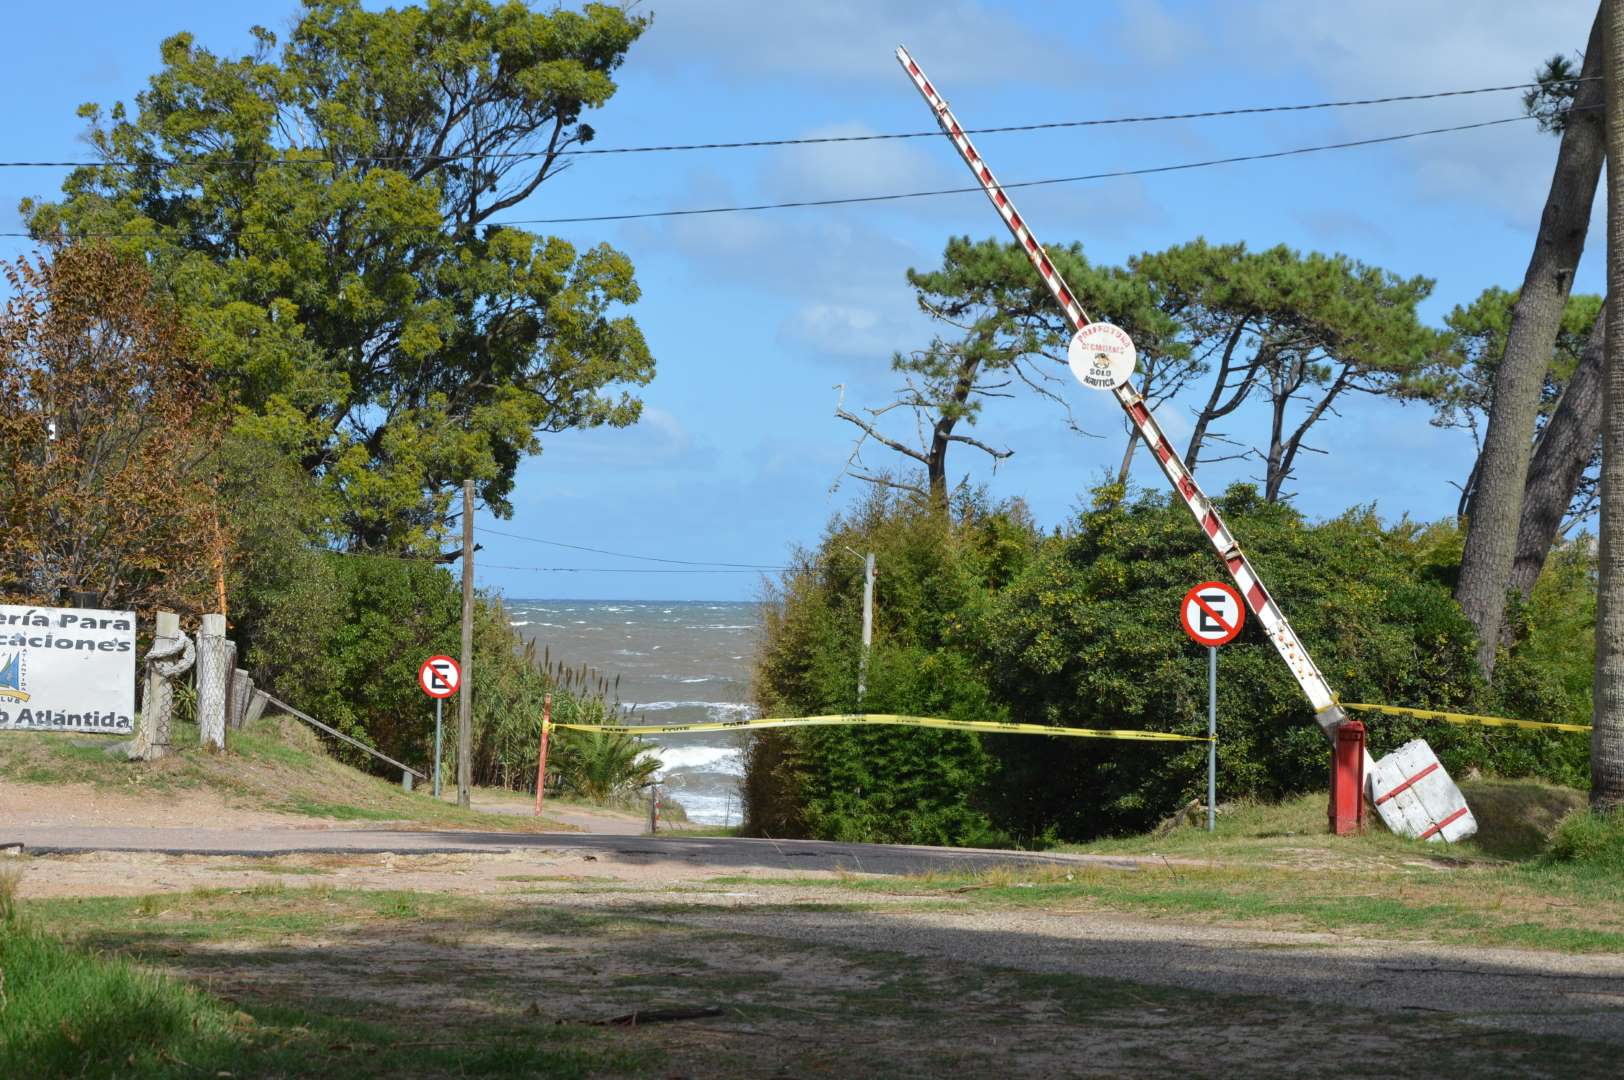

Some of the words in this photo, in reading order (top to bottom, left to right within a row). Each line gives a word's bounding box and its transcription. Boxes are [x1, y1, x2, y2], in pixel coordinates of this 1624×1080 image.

[1089, 368, 1112, 377] SOLO
[59, 614, 130, 631] Para
[15, 708, 130, 729] Atlántida
